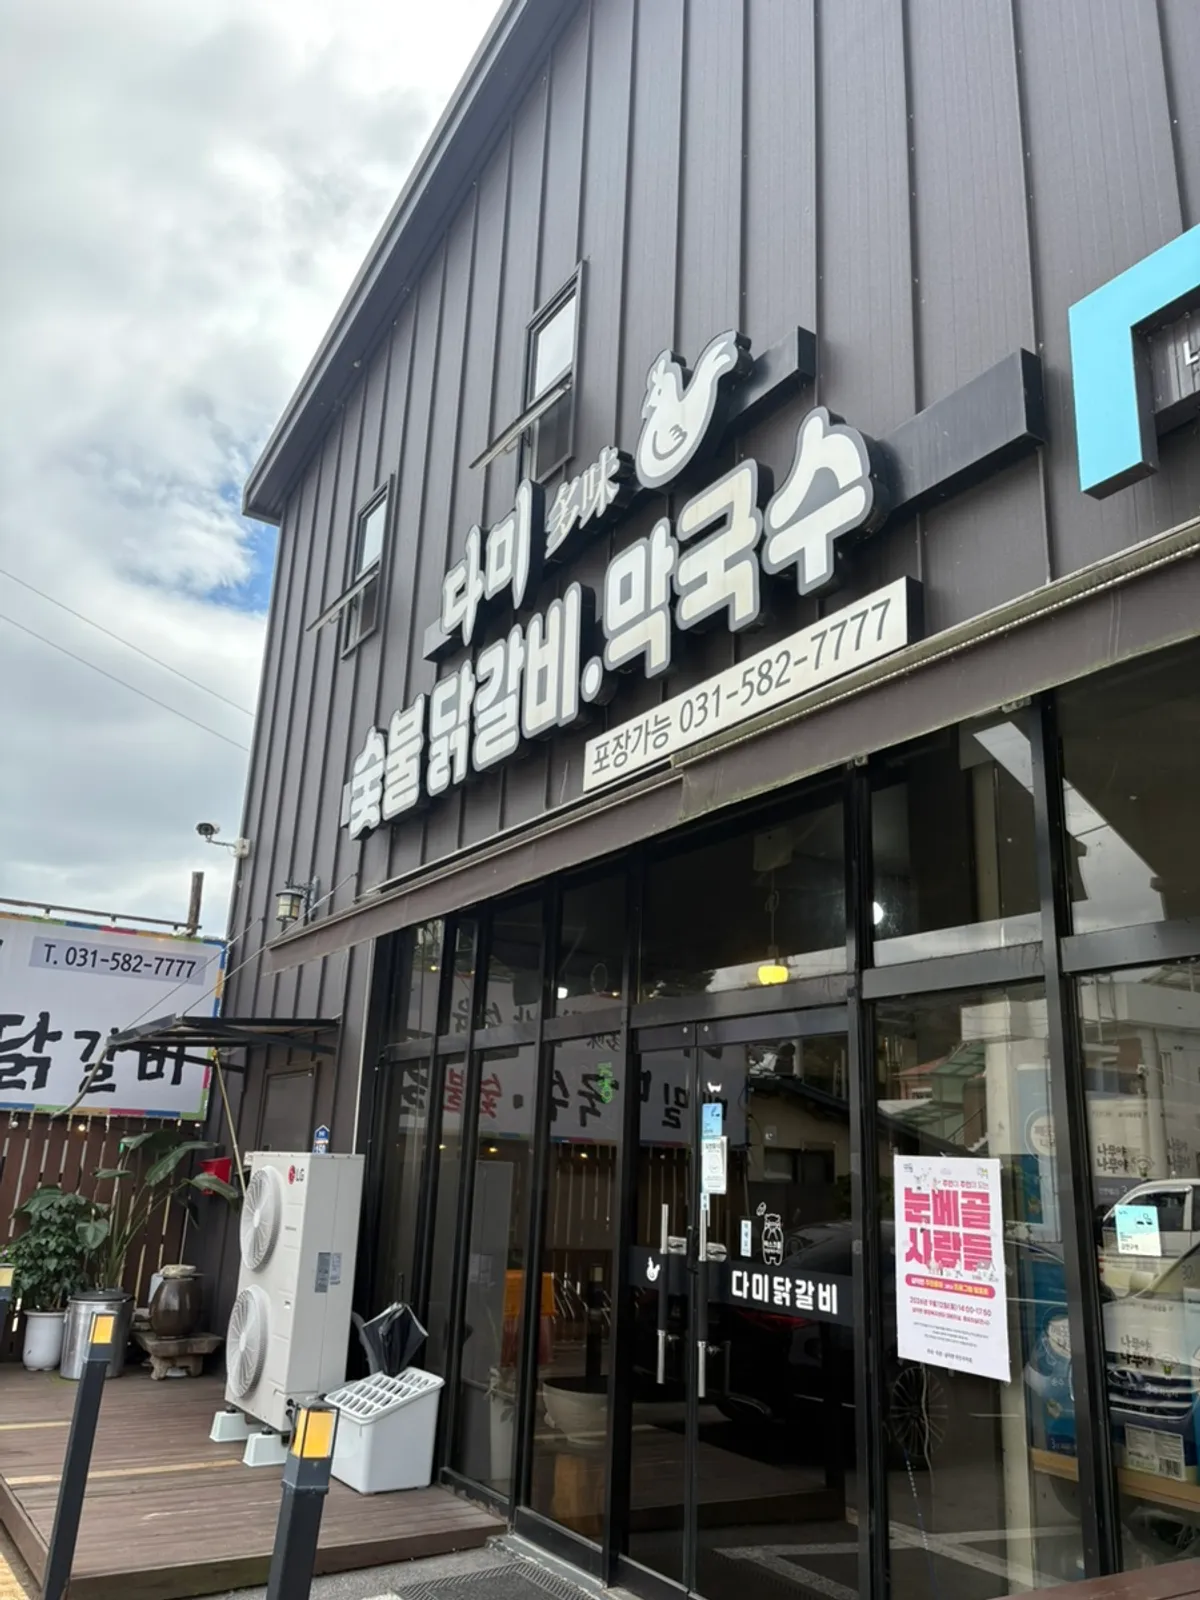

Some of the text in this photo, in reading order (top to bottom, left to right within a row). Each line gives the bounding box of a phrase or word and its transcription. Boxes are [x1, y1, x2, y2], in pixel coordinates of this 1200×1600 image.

[441, 478, 533, 646] 다미
[591, 598, 892, 776] 포장가능 031-582-7777
[44, 943, 197, 979] T. 031-582-7777
[1096, 1157, 1129, 1174] 나무야
